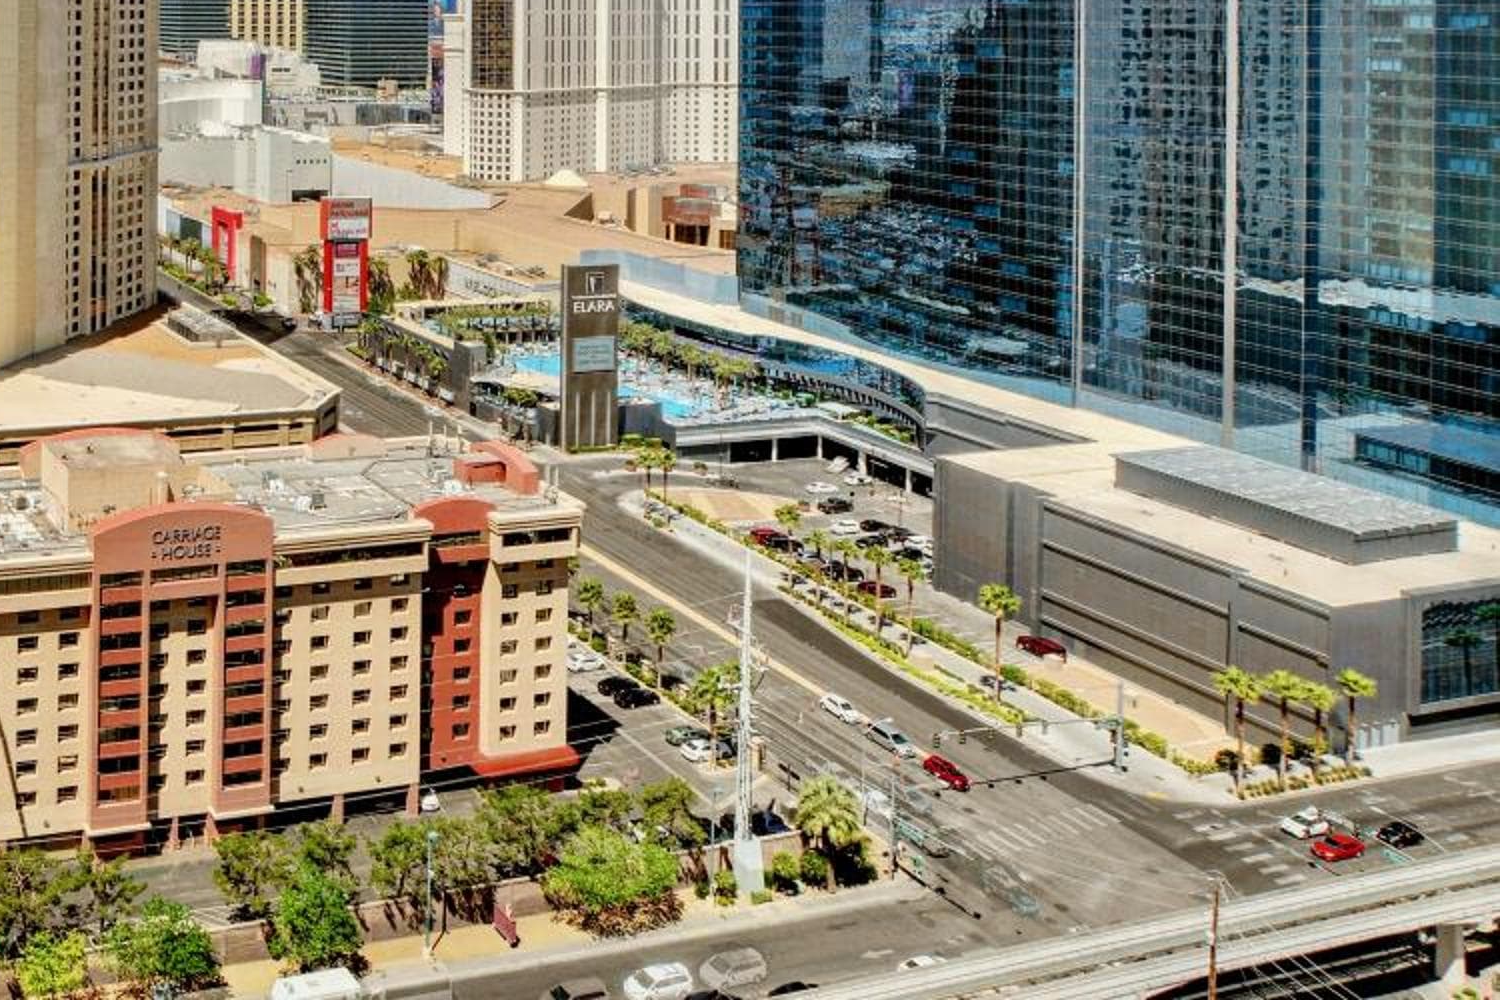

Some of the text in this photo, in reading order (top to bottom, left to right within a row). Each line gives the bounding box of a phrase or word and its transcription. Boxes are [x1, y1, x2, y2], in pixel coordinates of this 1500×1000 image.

[573, 300, 615, 313] ELARA
[152, 525, 222, 545] CARRIAGE
[161, 543, 212, 561] HOUSE
